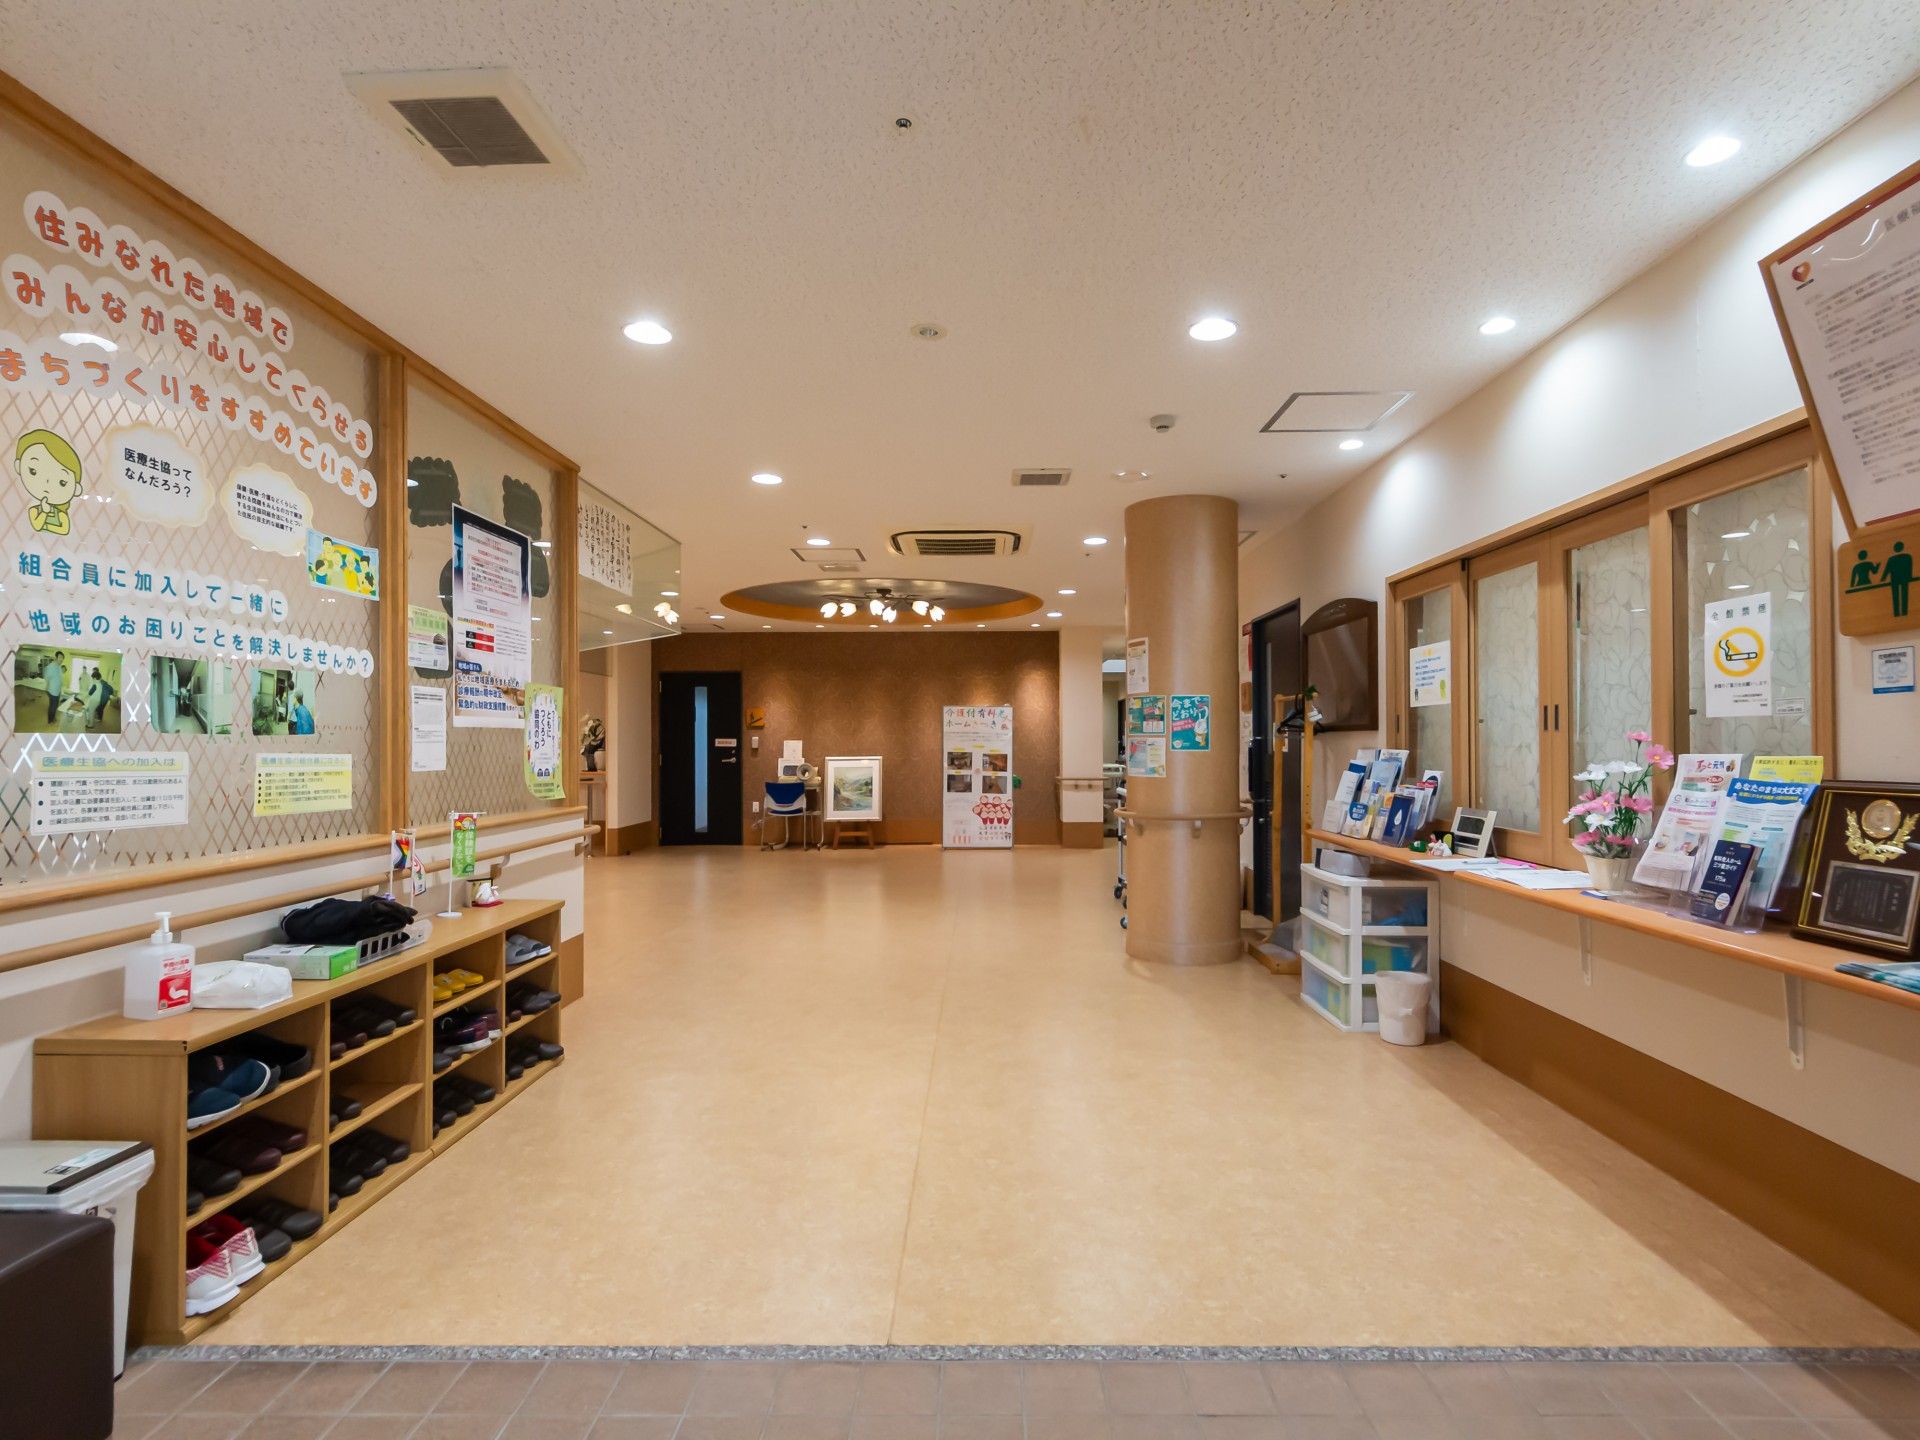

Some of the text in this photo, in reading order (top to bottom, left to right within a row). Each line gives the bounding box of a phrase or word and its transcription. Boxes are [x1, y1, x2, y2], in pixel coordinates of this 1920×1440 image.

[34, 206, 289, 346] 住みなれた地域で
[124, 447, 192, 481] 医療生協って
[124, 468, 192, 498] なんだろう？
[19, 551, 284, 617] 組合員に加入して一緒に
[42, 756, 176, 767] 医療生協への加入は
